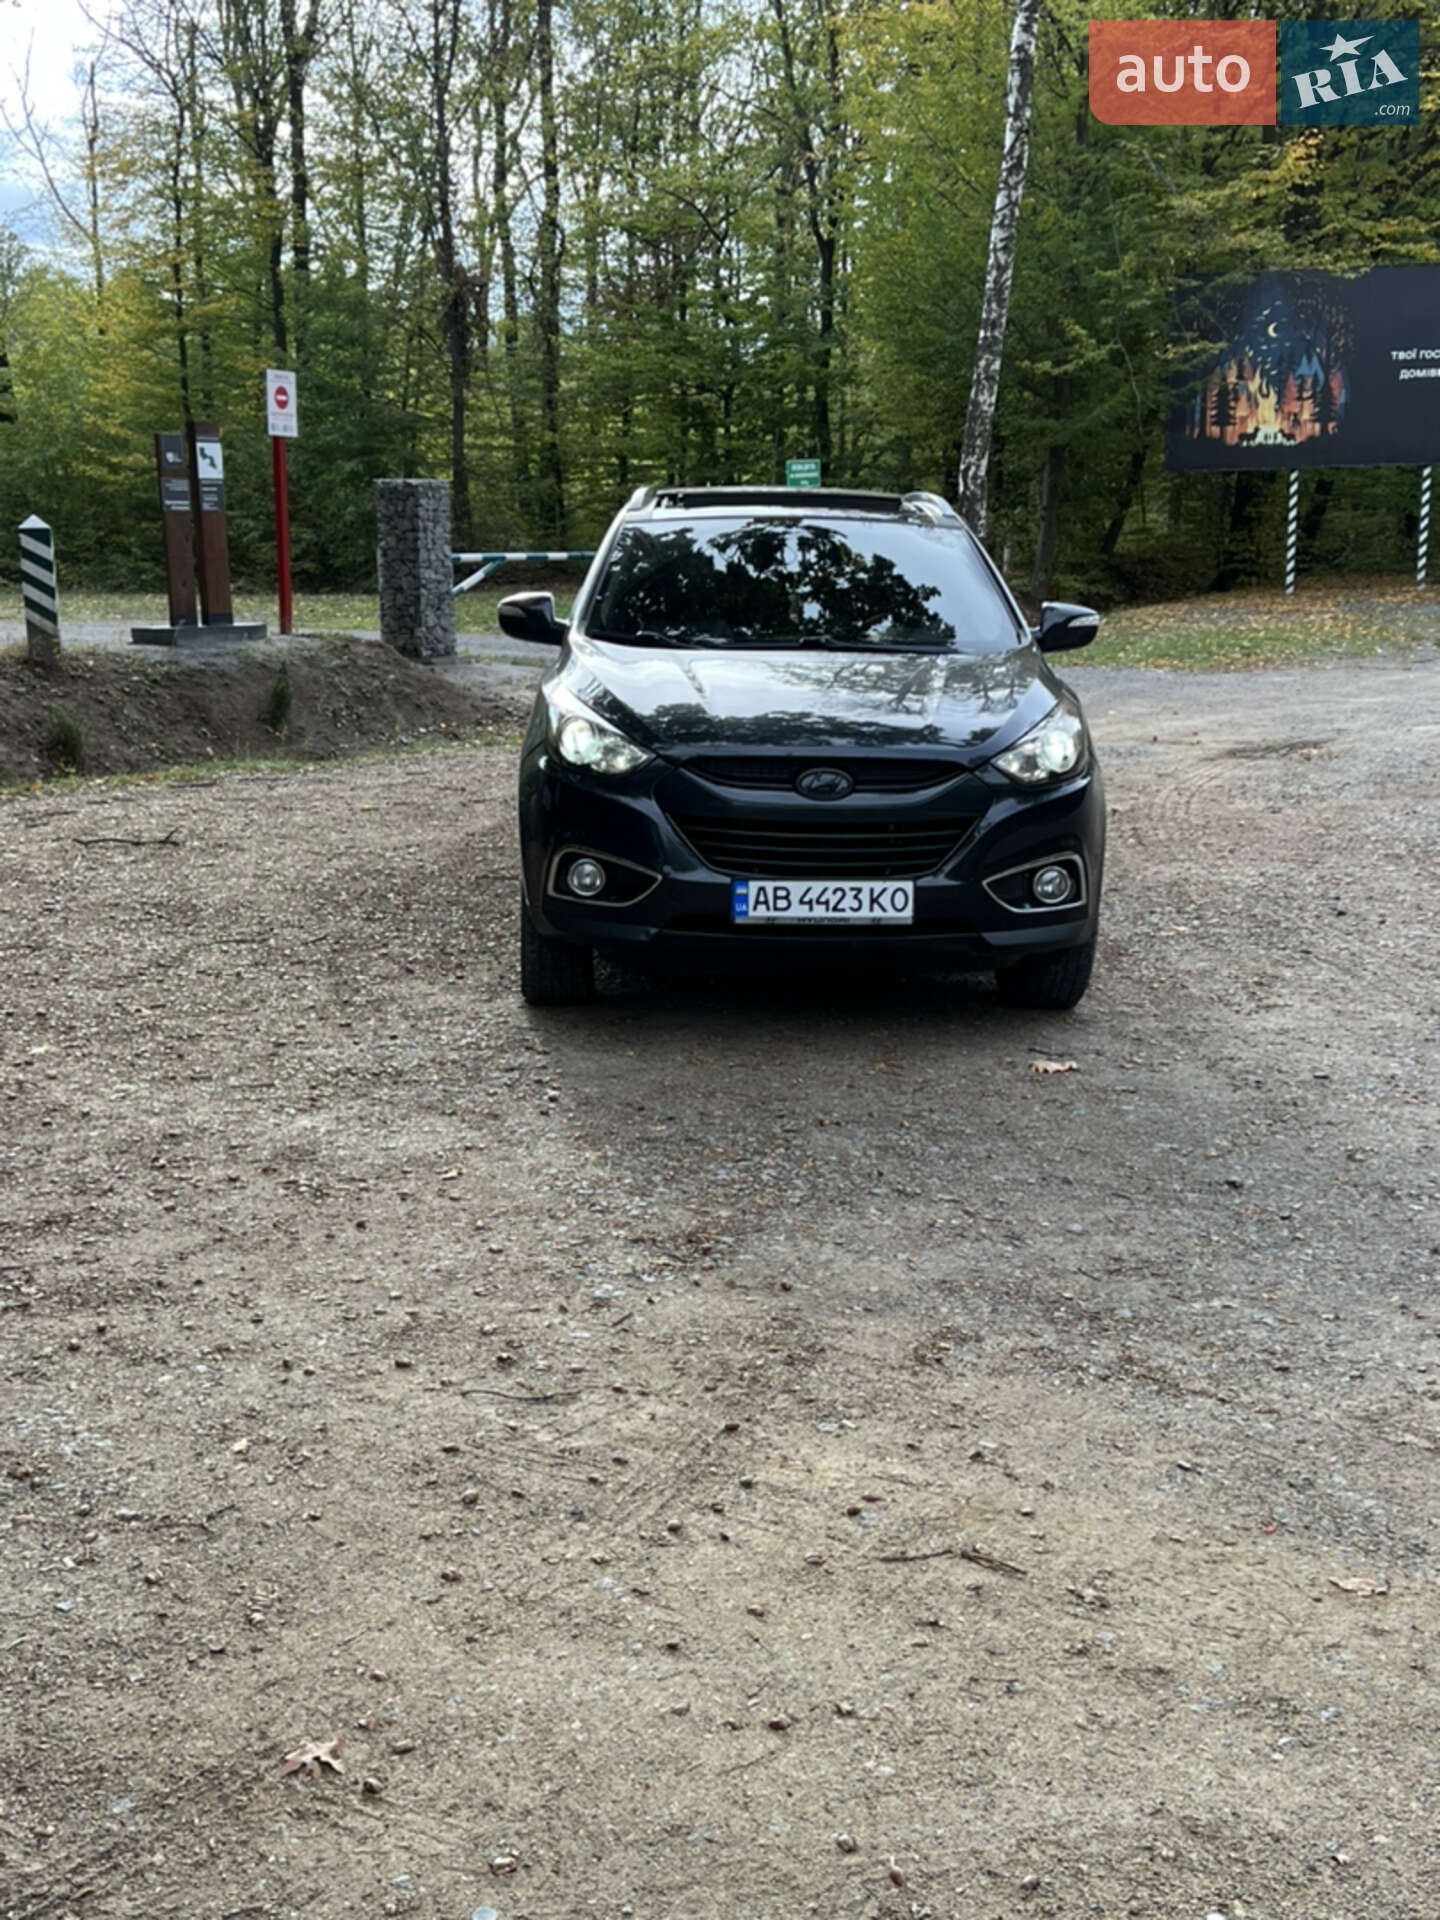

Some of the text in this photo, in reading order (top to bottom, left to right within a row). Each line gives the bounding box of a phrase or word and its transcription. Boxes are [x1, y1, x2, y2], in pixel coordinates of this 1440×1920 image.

[735, 903, 748, 912] UA
[752, 885, 909, 913] AB 4423 KO
